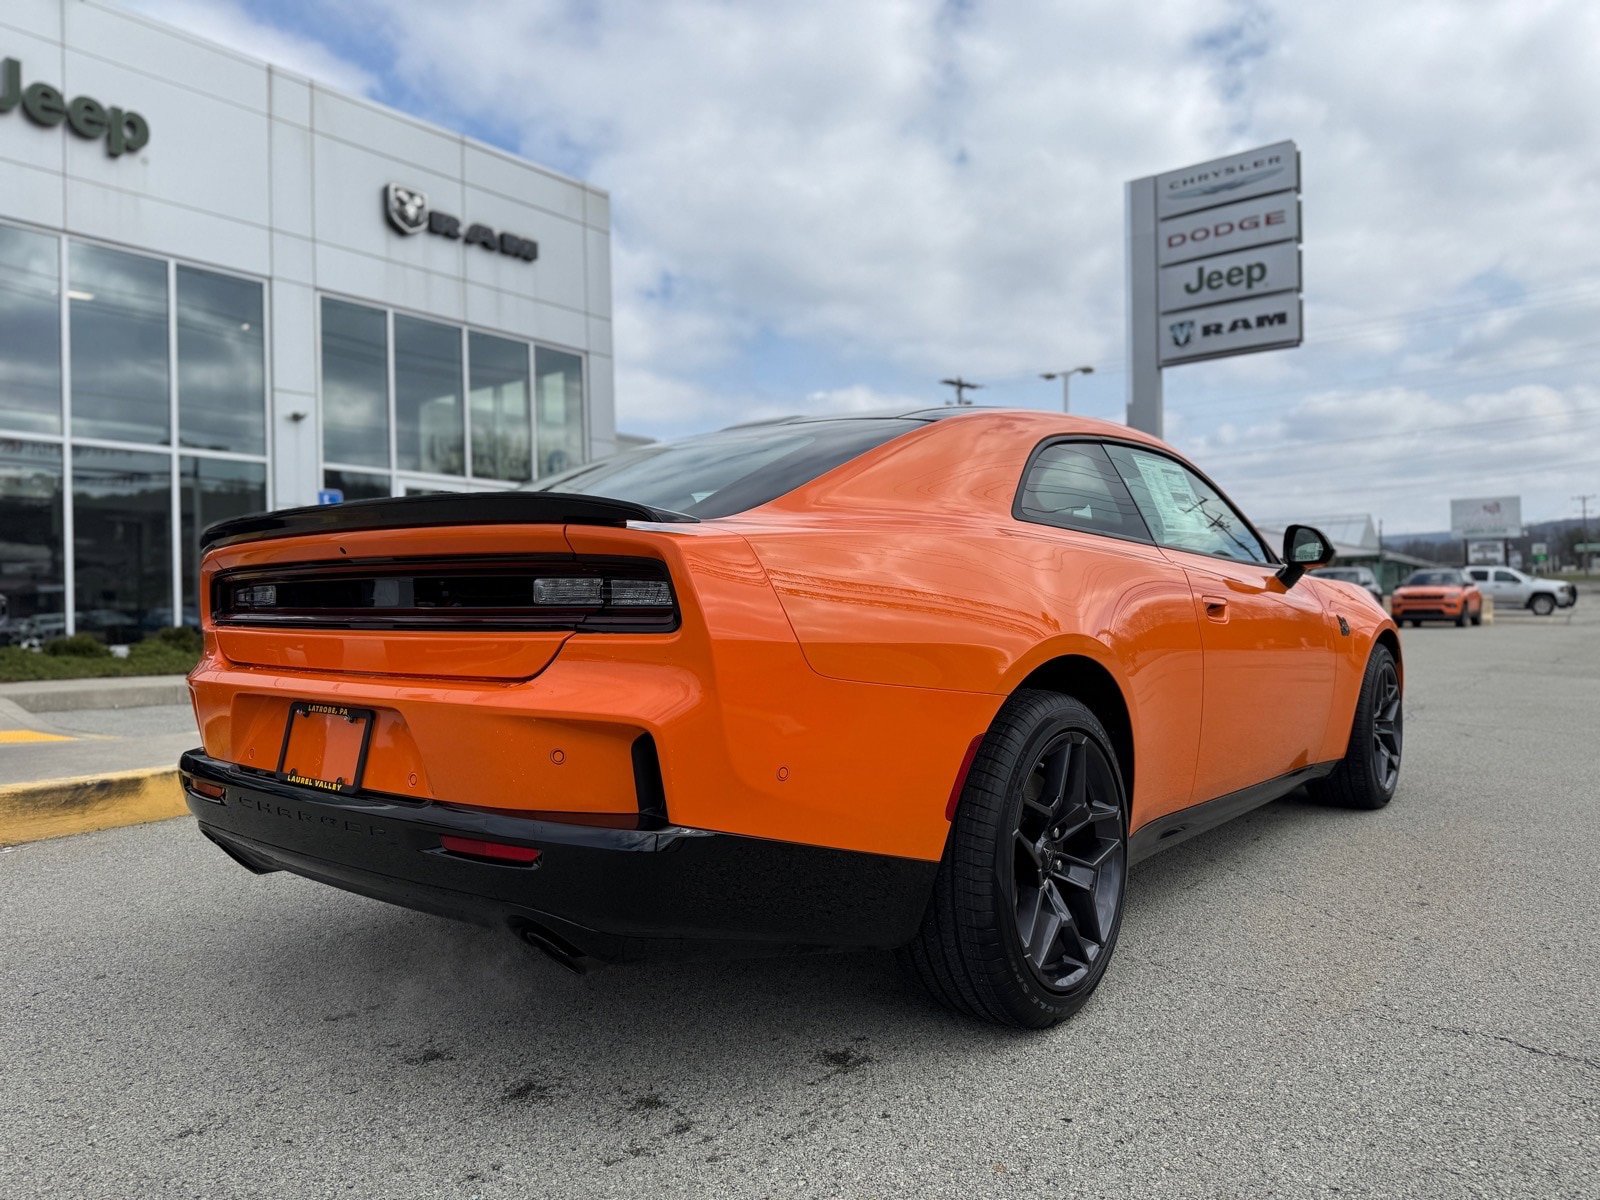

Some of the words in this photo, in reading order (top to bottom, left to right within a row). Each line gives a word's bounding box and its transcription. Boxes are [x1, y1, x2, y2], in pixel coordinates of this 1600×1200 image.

[0, 57, 149, 160] Jeep
[1168, 155, 1281, 191] CHRYSLER
[428, 210, 539, 263] RAM
[1167, 210, 1286, 248] DODGE
[1184, 261, 1267, 294] Jeep
[1202, 312, 1288, 338] RAM
[339, 708, 348, 716] PA
[287, 775, 313, 786] LAUREL
[314, 780, 342, 791] VALLEY
